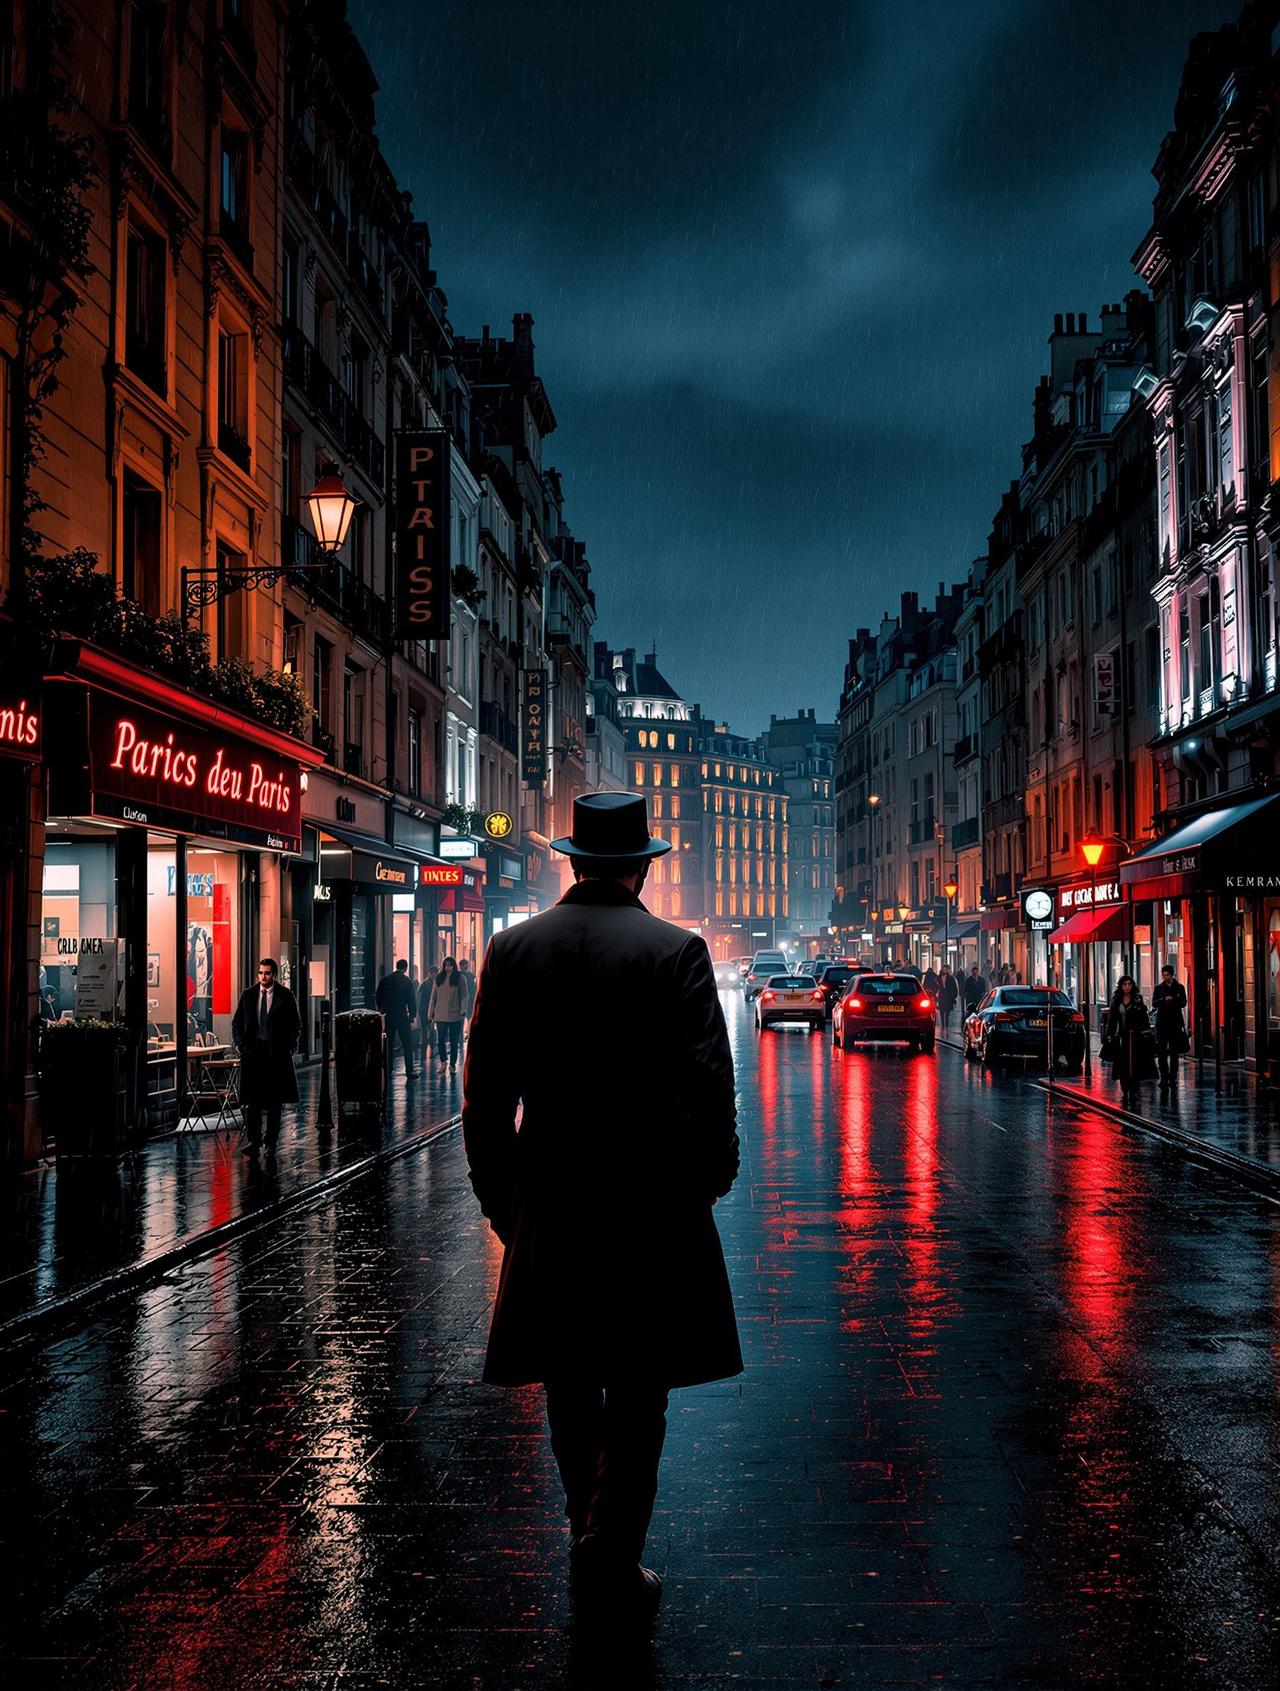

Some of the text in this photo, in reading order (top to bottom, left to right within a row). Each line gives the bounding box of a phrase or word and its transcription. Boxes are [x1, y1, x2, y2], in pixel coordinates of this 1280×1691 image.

[111, 720, 197, 787] Parics
[207, 750, 242, 799] deu
[247, 763, 290, 812] Paris
